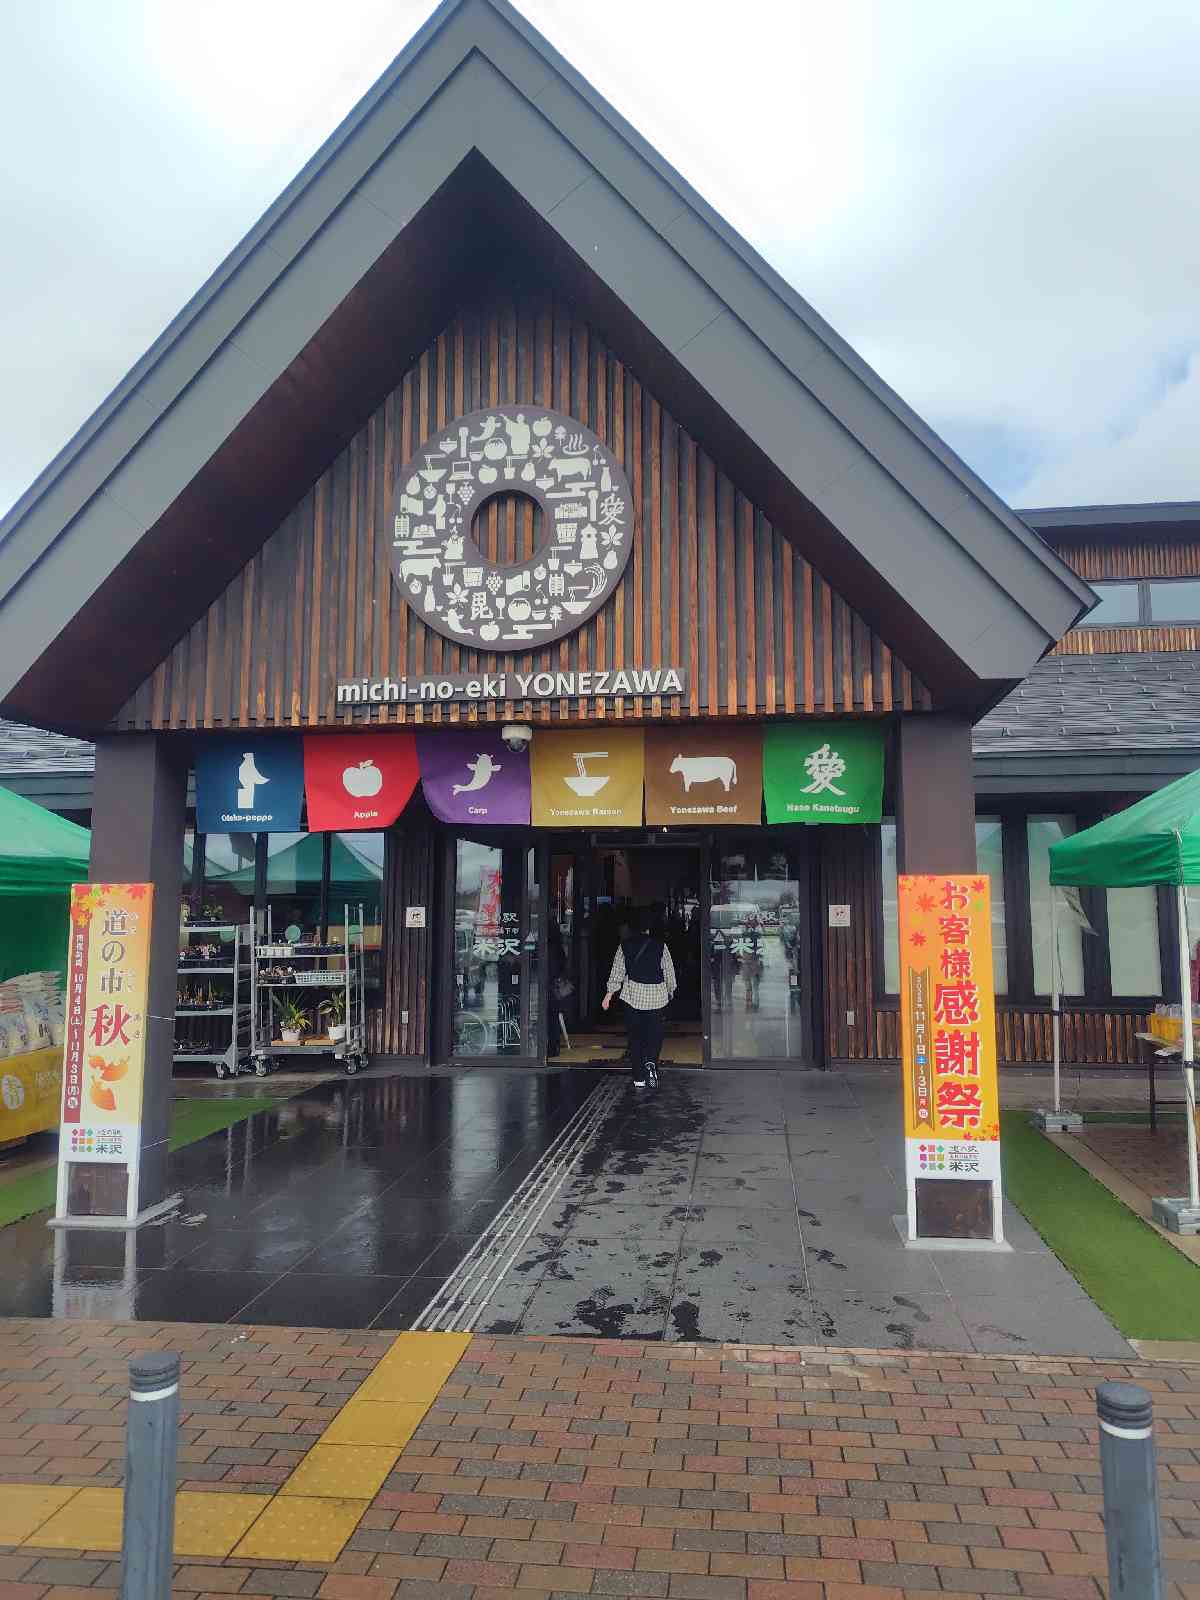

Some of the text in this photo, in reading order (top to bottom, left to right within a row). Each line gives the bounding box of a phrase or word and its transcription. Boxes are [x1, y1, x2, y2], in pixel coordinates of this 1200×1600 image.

[336, 669, 684, 702] michi-no-eki YONEZAWA
[800, 743, 847, 796] 愛
[353, 809, 378, 819] Apple
[468, 805, 488, 815] Carp
[550, 807, 590, 817] Yonezawa
[670, 804, 737, 814] Yonezawa Beef
[88, 910, 131, 1047] 道の市 秋
[934, 880, 981, 1128] お客様感謝祭
[949, 1161, 979, 1172] 米沢
